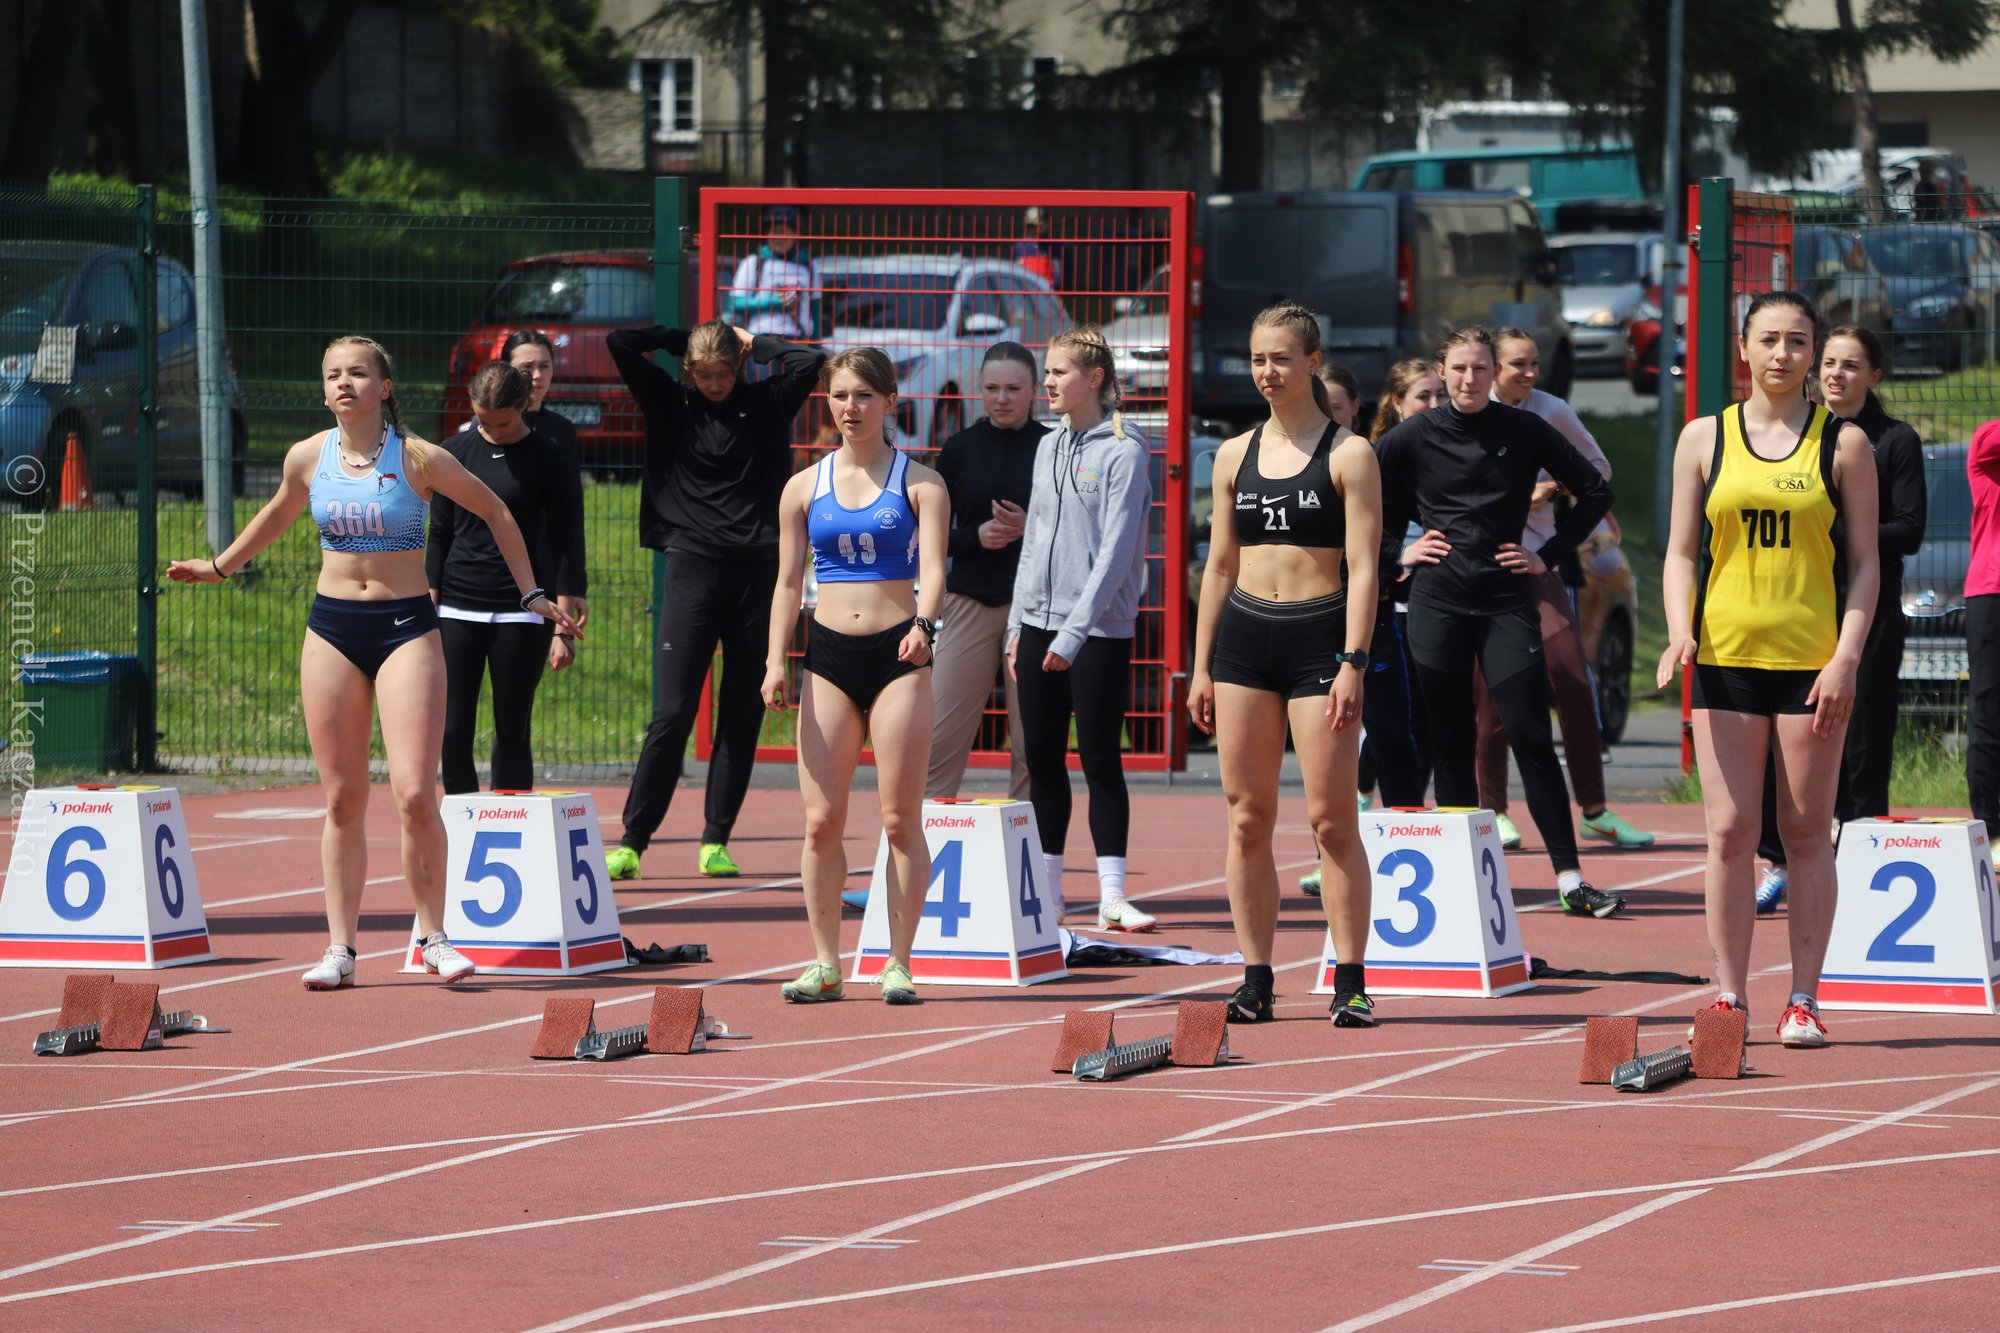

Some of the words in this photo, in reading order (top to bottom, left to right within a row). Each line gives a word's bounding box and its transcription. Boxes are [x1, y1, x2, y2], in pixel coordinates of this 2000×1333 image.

[1777, 480, 1805, 490] OSA
[326, 500, 385, 537] 364
[1262, 507, 1290, 530] 21
[1741, 509, 1791, 549] 701
[838, 532, 876, 565] 43
[62, 801, 114, 815] polanik
[152, 800, 172, 815] polanik
[478, 808, 528, 821] polanik
[567, 804, 586, 820] polanik
[925, 815, 976, 830] polanik
[1013, 814, 1029, 829] polanik
[1389, 824, 1444, 839] polanik
[1884, 836, 1942, 850] polanik
[46, 825, 108, 922] 6
[155, 823, 184, 919] 6
[461, 831, 523, 928] 5
[569, 828, 598, 925] 5
[1020, 837, 1042, 935] 4
[921, 840, 971, 938] 4
[1373, 848, 1437, 948] 3
[1481, 847, 1506, 946] 3
[1866, 861, 1937, 963] 2
